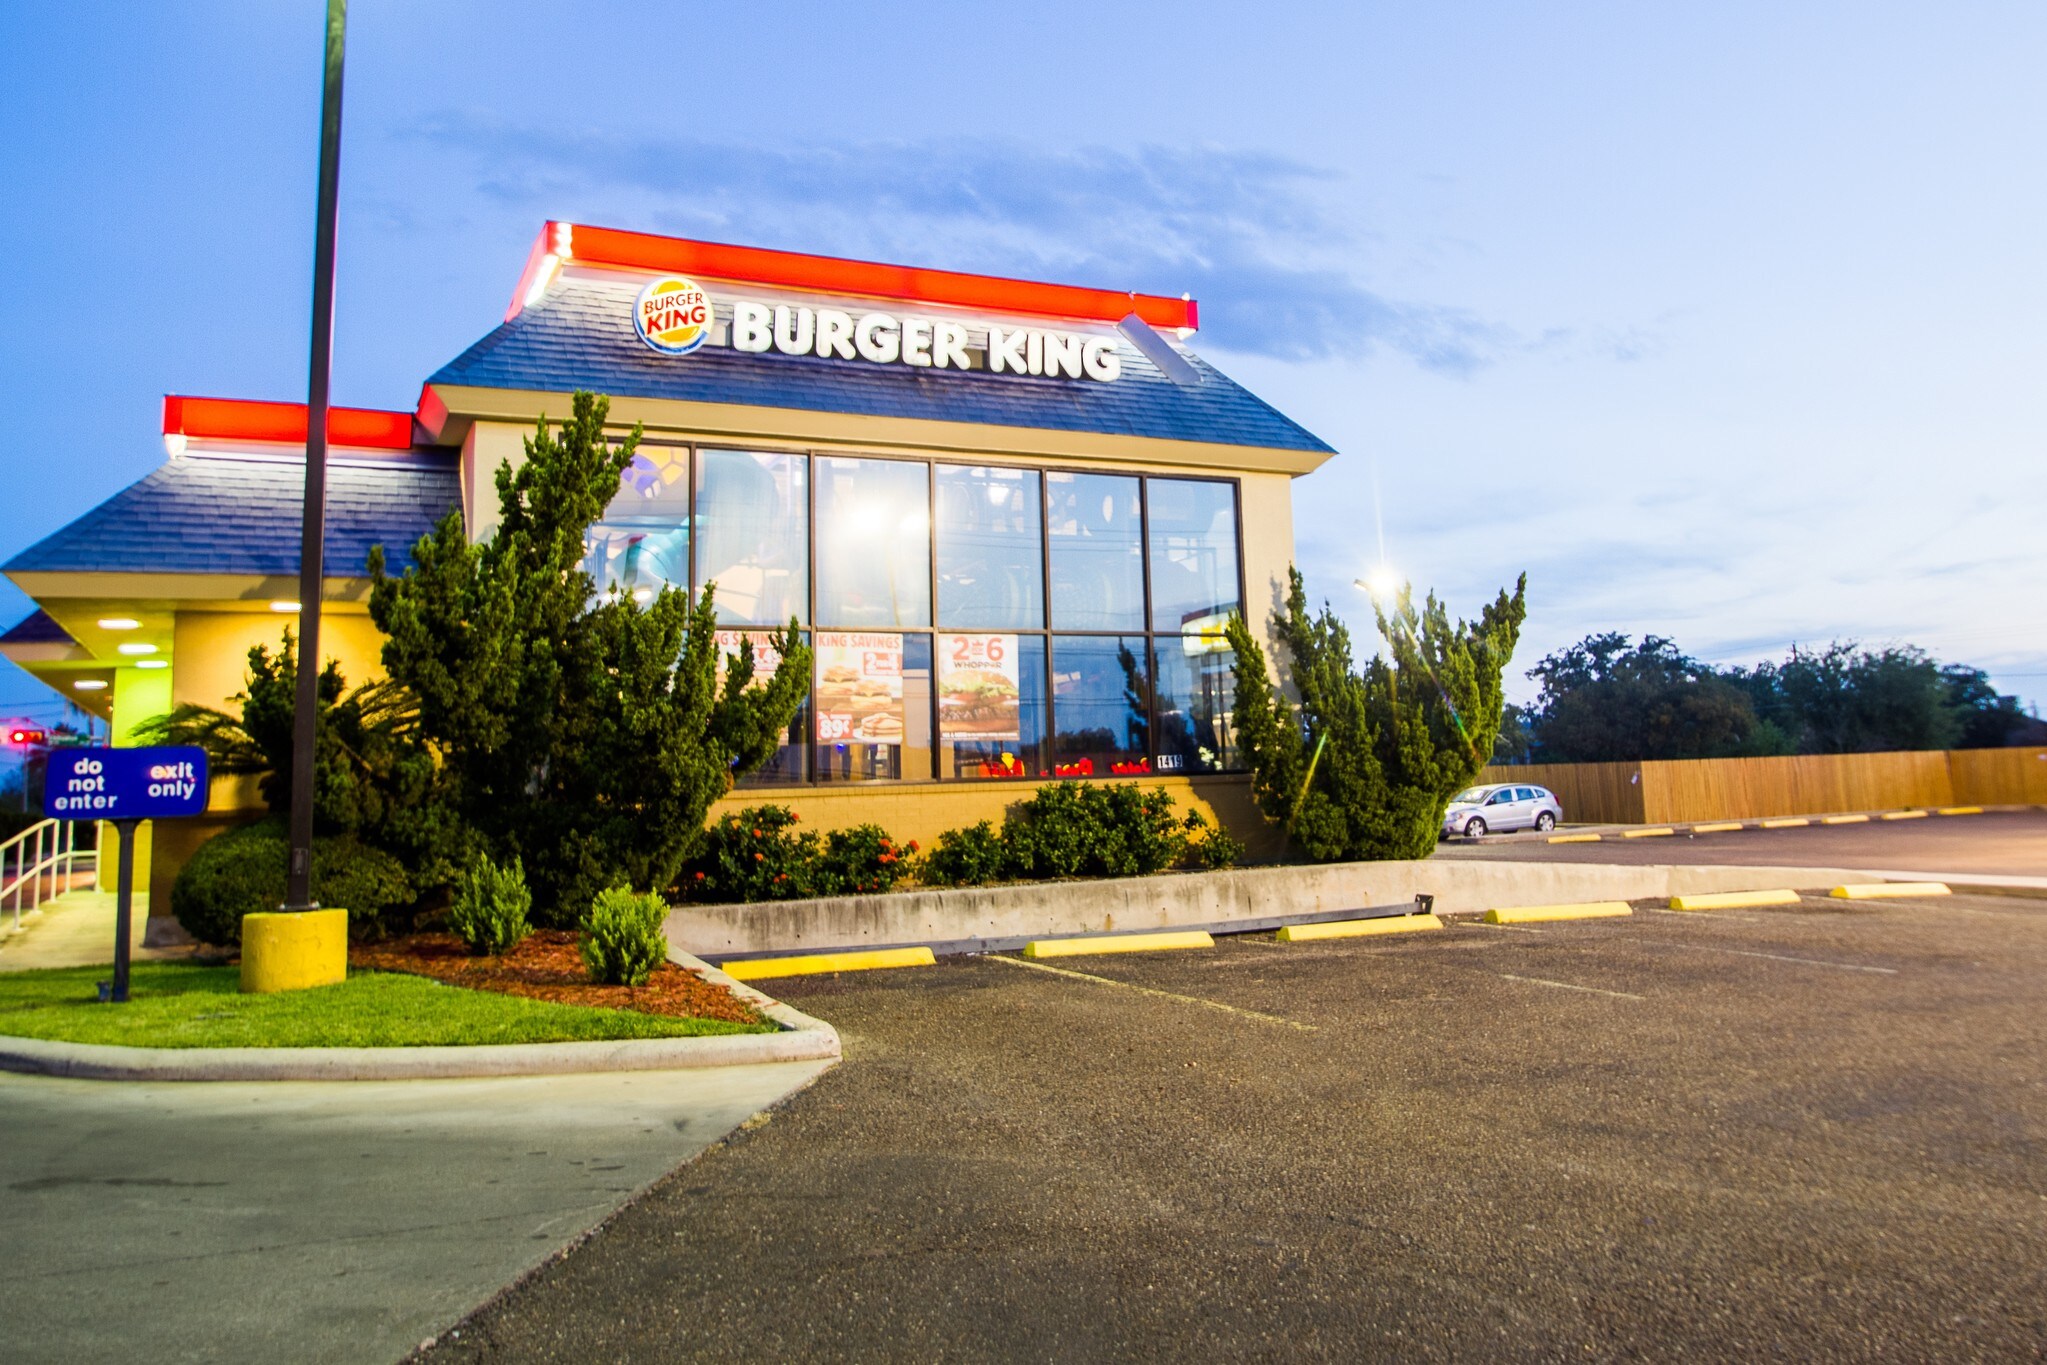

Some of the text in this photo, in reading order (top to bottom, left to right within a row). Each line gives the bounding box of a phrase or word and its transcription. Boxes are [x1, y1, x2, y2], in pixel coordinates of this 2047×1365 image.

[644, 293, 704, 315] BURGER
[646, 306, 706, 335] KING
[732, 300, 1122, 382] BURGER KING
[818, 634, 900, 649] KING SAVINGS
[953, 636, 969, 661] 2
[986, 637, 1004, 661] 6
[74, 758, 103, 775] do
[1158, 754, 1182, 768] 1419
[150, 762, 194, 780] exit
[68, 775, 105, 792] not
[148, 780, 196, 800] only
[54, 793, 118, 811] enter
